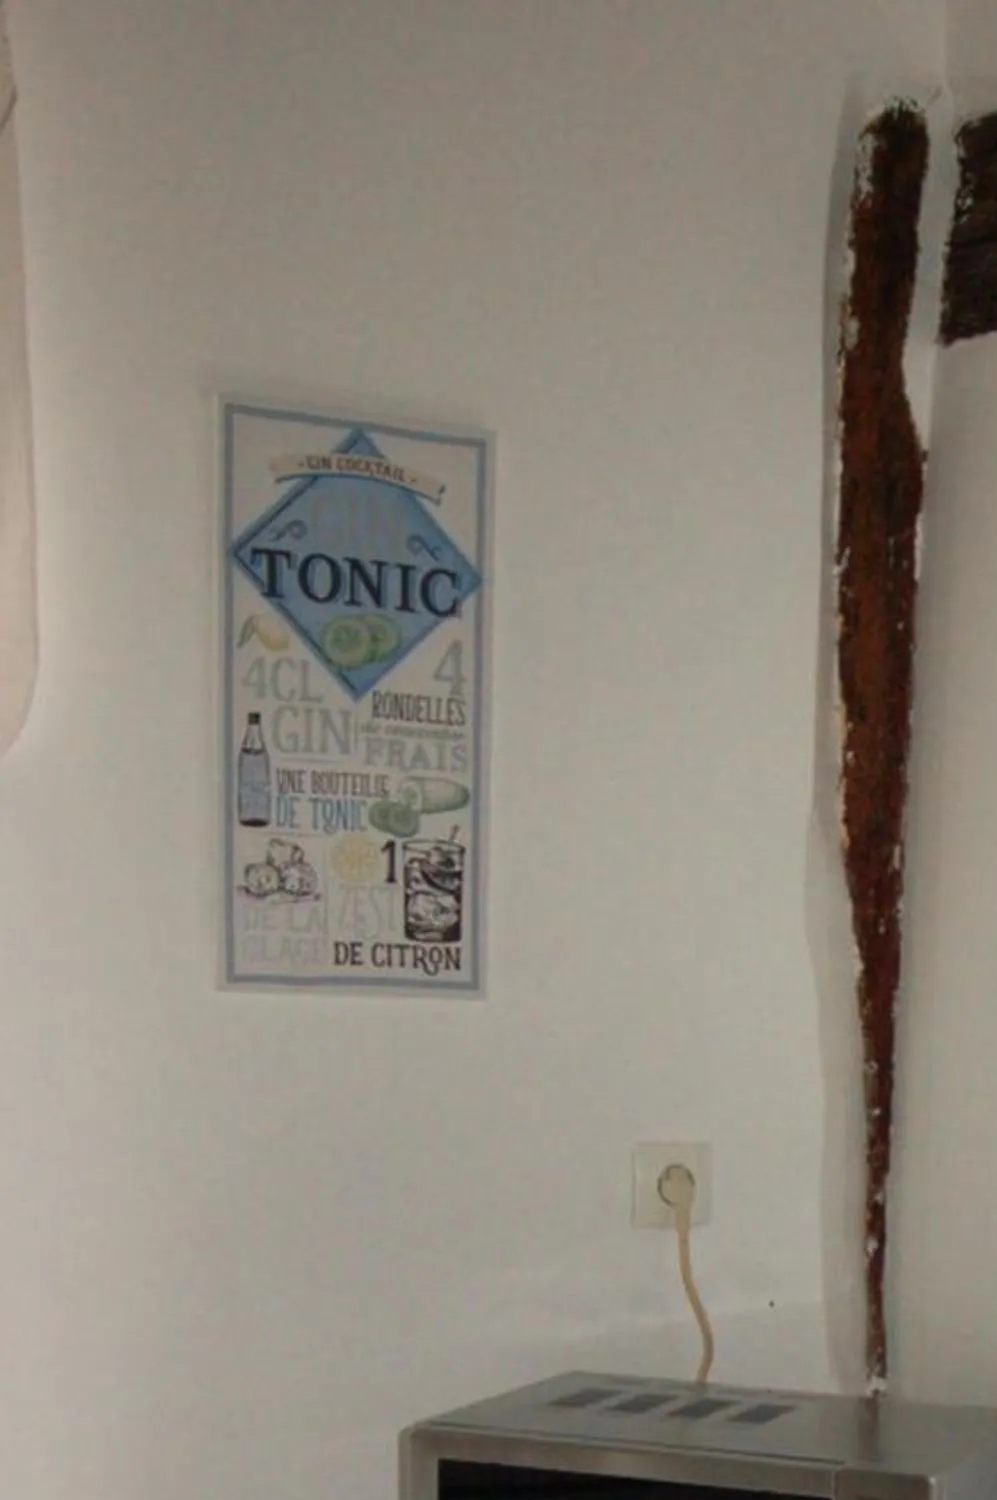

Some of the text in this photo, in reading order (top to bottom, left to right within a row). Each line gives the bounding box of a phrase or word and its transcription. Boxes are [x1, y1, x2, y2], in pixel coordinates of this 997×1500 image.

[250, 547, 463, 618] TONIC
[432, 639, 468, 696] 4
[372, 690, 467, 727] RONDELLES
[271, 705, 353, 755] GIN
[363, 737, 468, 773] FRAIS
[276, 768, 306, 794] UNE
[276, 796, 368, 835] DE TONIC
[380, 839, 398, 884] 1
[332, 940, 462, 976] DE CITRON
